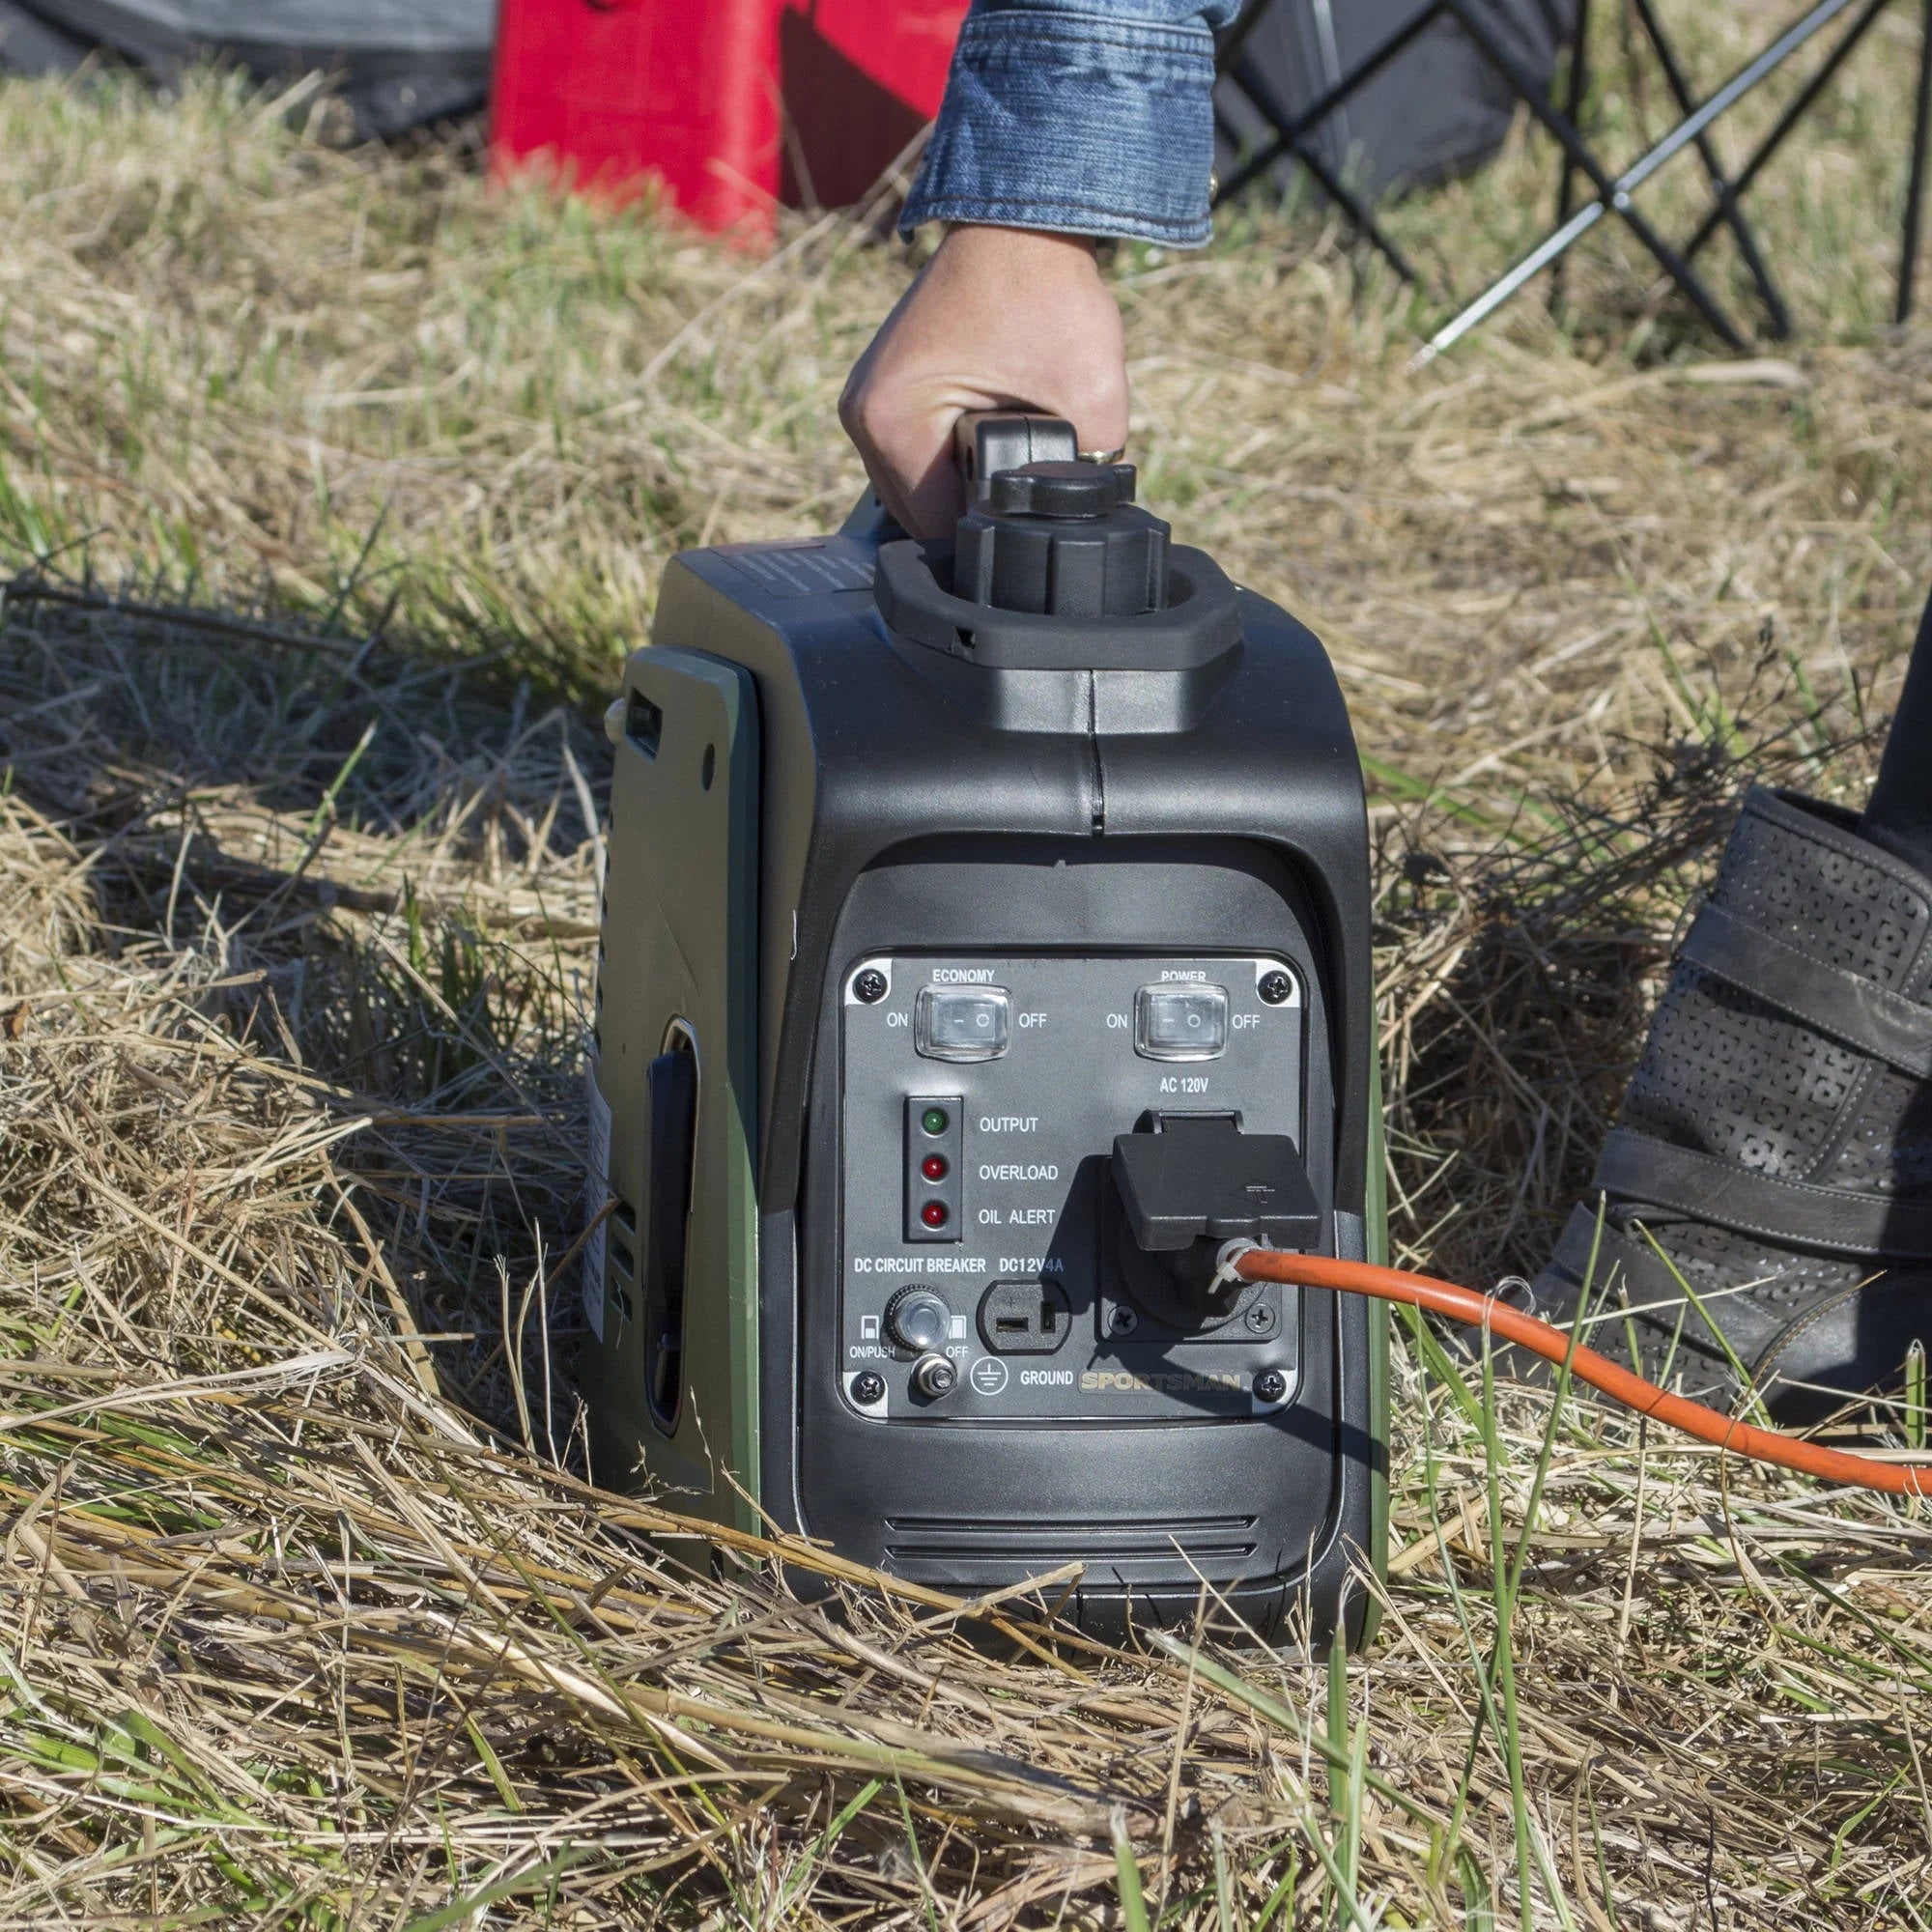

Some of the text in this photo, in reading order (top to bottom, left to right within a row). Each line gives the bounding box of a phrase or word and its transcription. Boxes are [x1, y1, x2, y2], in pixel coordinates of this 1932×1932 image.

[932, 969, 995, 982] ECONOMY
[1161, 971, 1207, 982] POWER
[887, 1012, 908, 1027] ON
[1018, 1012, 1047, 1028] OFF
[1106, 1013, 1128, 1029] ON
[1232, 1014, 1261, 1029] OFF
[1159, 1077, 1208, 1093] AC 120V
[980, 1117, 1038, 1132] OUTPUT
[979, 1165, 1059, 1180] OVERLOAD
[979, 1209, 1056, 1224] OIL ALERT
[854, 1258, 986, 1273] DC CIRCUIT BREAKER
[849, 1346, 895, 1358] ON/PUSH
[946, 1346, 969, 1358] OFF
[1020, 1370, 1074, 1385] GROUND
[1081, 1372, 1240, 1391] SPORTSMAN
